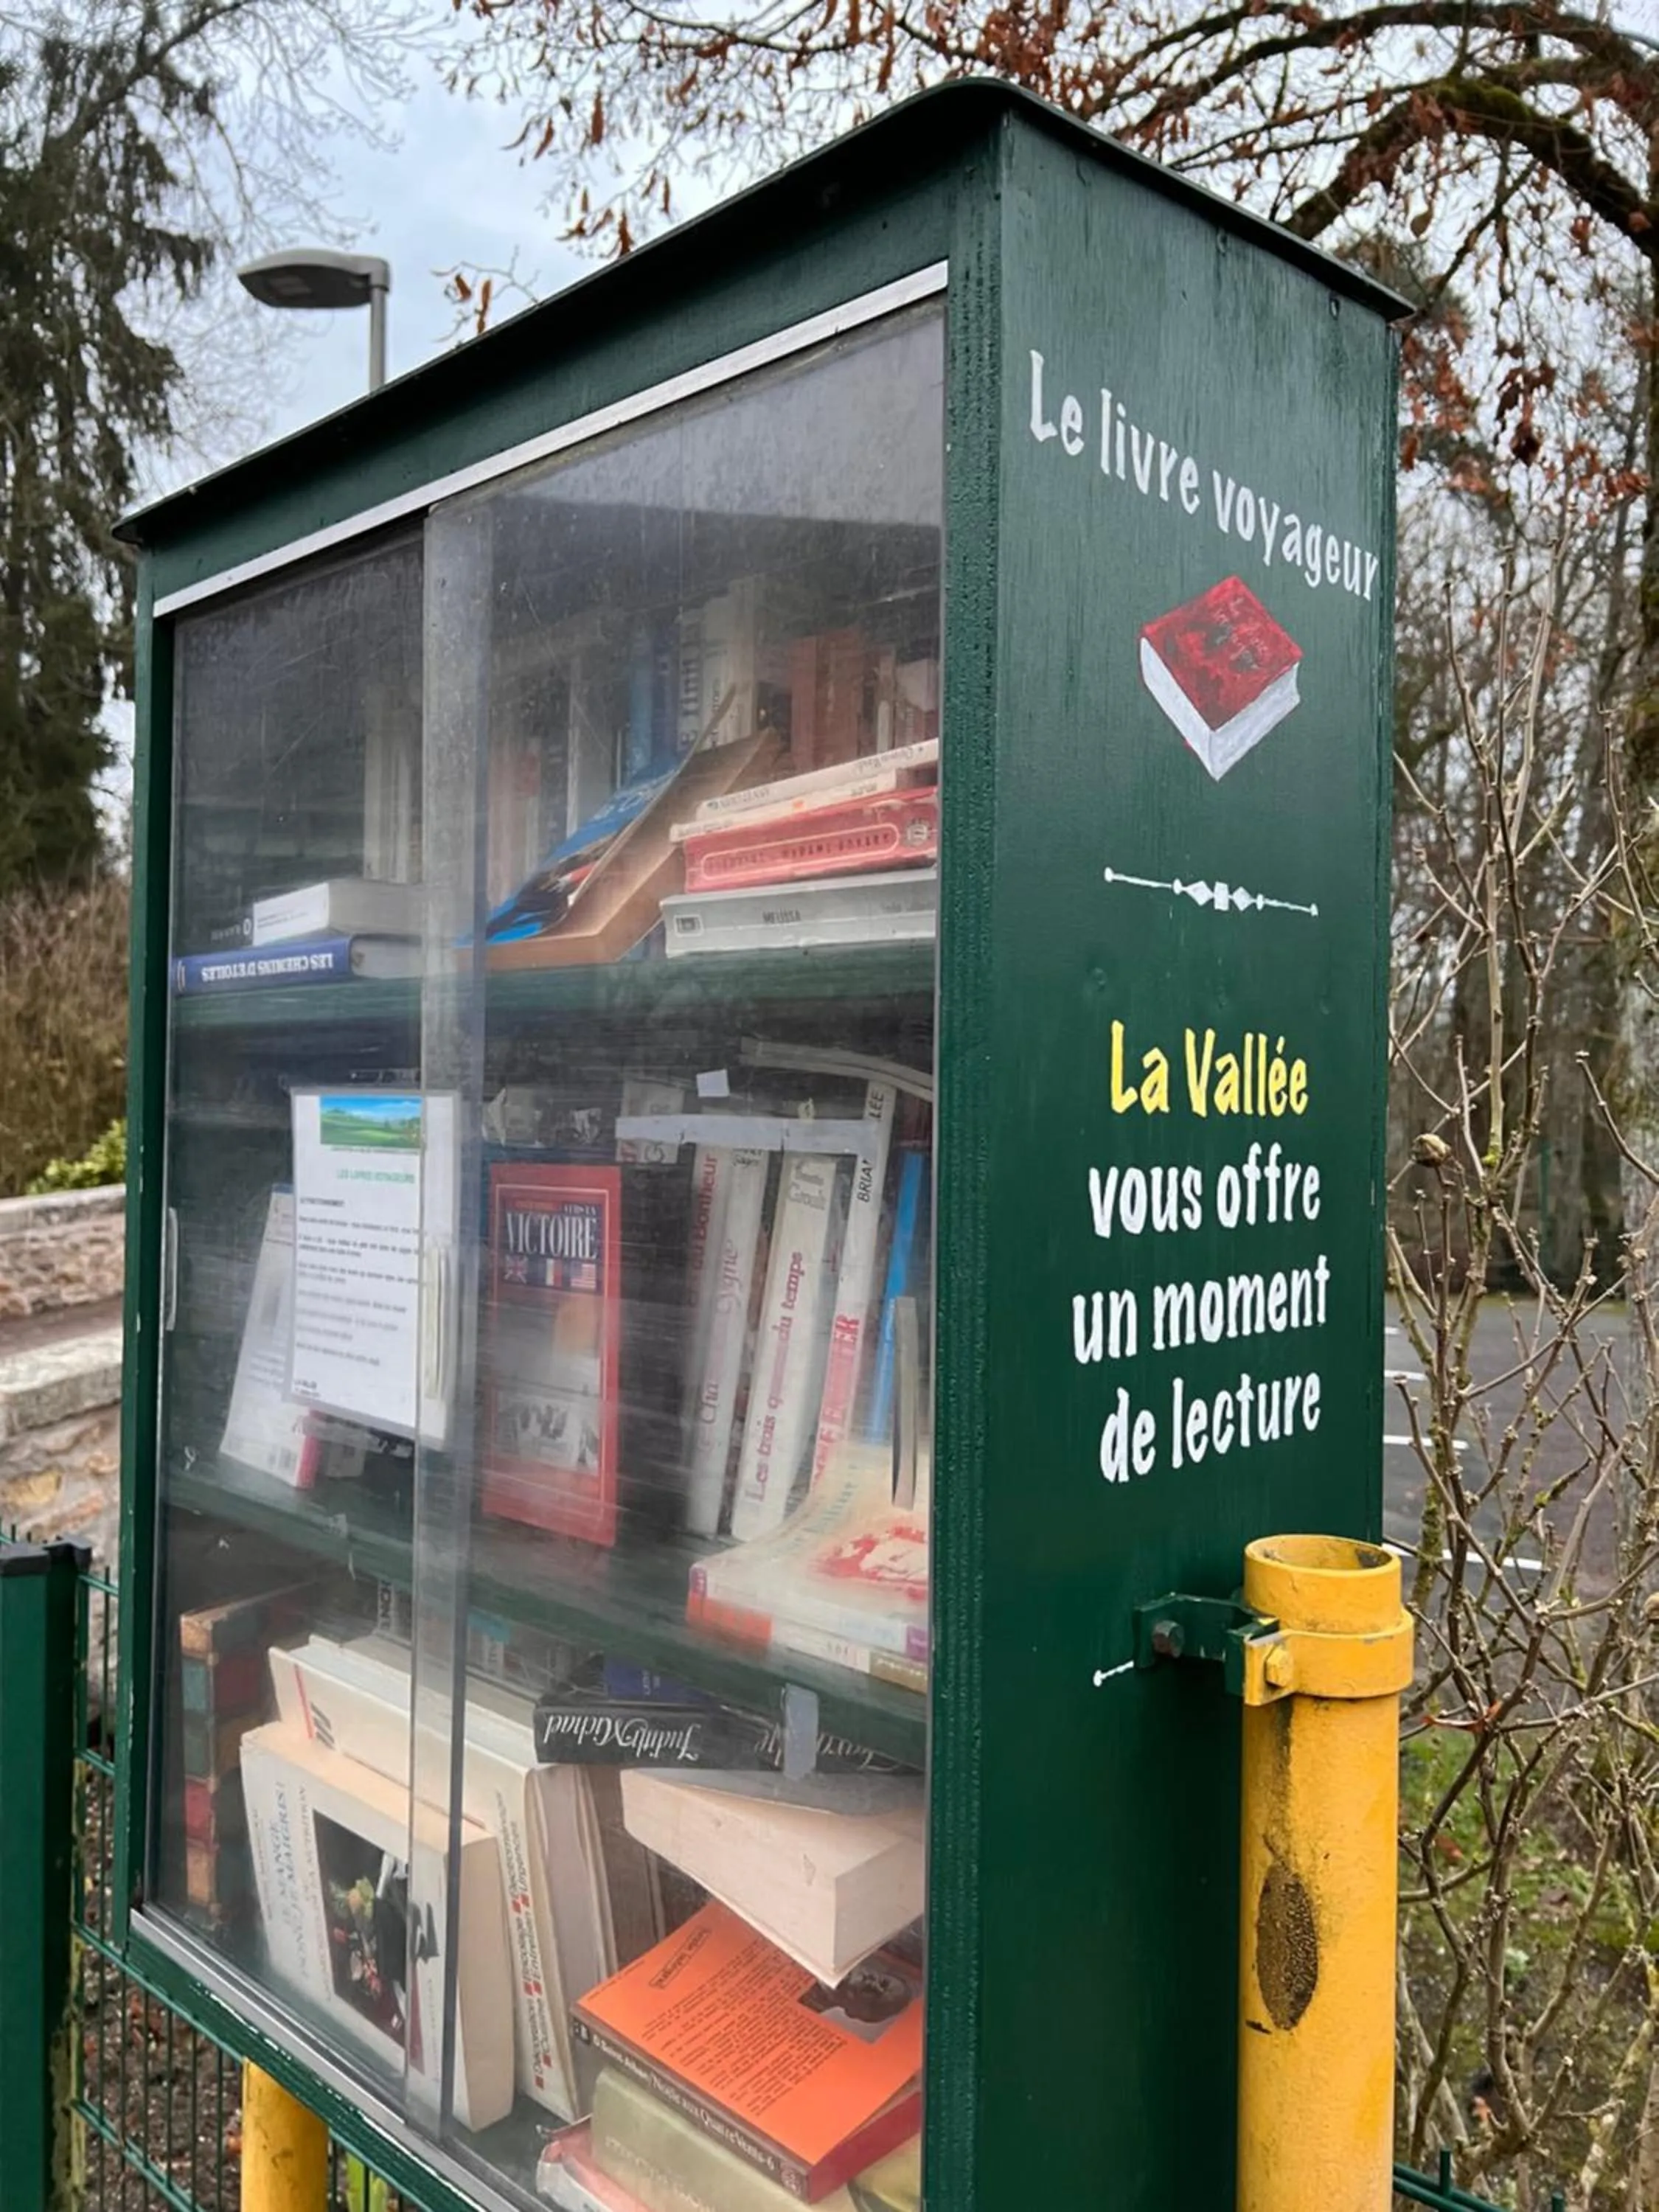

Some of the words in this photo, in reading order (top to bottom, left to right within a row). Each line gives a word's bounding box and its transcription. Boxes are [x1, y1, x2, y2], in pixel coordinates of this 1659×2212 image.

[1029, 349, 1085, 455] Le
[1101, 388, 1200, 515] livre
[1213, 470, 1378, 601] voyageur
[257, 956, 308, 975] CHEMINS
[310, 953, 334, 970] LES
[1111, 1020, 1169, 1113] La
[1186, 1028, 1309, 1118] Vallée
[1089, 1166, 1203, 1238] vous
[1217, 1142, 1321, 1228] offre
[507, 1212, 597, 1260] VICTOIRE
[780, 1251, 806, 1310] temps
[1073, 1290, 1136, 1364] un
[1153, 1255, 1330, 1350] moment
[1100, 1388, 1156, 1483] de
[1172, 1372, 1320, 1470] lecture
[543, 1714, 647, 1749] Michael
[631, 1722, 701, 1761] Judith
